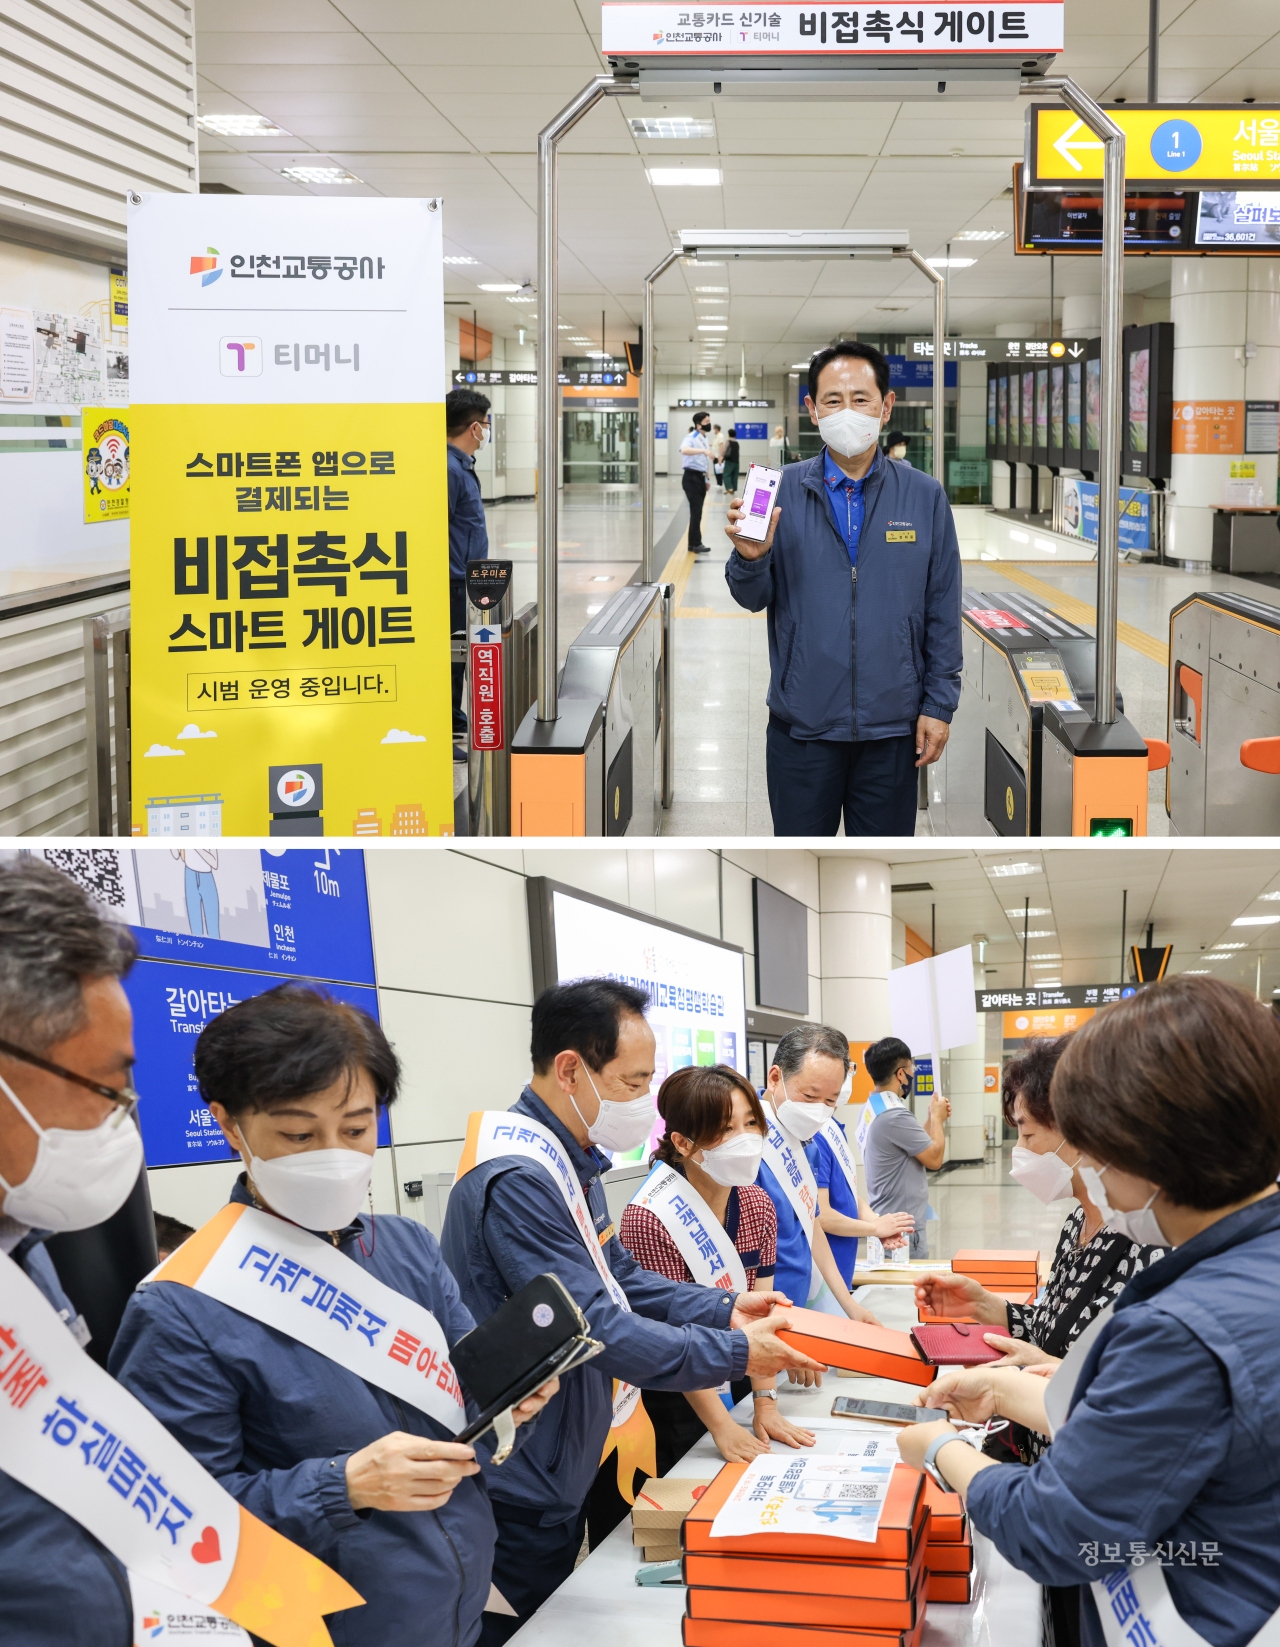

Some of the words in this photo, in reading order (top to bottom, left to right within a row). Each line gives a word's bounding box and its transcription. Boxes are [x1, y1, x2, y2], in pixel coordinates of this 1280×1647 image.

[678, 12, 734, 28] 교통카드
[740, 12, 782, 27] 신기술
[800, 11, 924, 43] 비접촉식
[934, 10, 1028, 42] 게이트
[666, 32, 722, 42] 인천교통공사
[754, 32, 780, 42] 티머니
[1172, 131, 1179, 149] 1
[1232, 150, 1264, 161] Seoul
[230, 254, 386, 280] 인천교통공사
[274, 343, 360, 372] 티머니
[186, 452, 302, 478] 스마트폰
[312, 451, 395, 475] 앱으로
[236, 485, 349, 512] 결제되는
[173, 531, 408, 600] 비접촉식
[470, 568, 508, 579] 도우미폰
[168, 610, 286, 652] 스마트
[302, 606, 415, 650] 게이트
[196, 681, 239, 702] 시범
[248, 678, 290, 700] 운영
[299, 674, 389, 698] 중입니다.
[478, 648, 494, 702] 역직원
[478, 708, 495, 744] 호출
[270, 890, 291, 900] Jemulpo
[314, 870, 340, 898] 10m
[274, 924, 295, 944] 인천
[276, 943, 296, 952] Incheon
[982, 994, 1023, 1008] 갈아타는
[1026, 992, 1036, 1006] 곳
[185, 1130, 203, 1138] Seoul
[204, 1128, 224, 1137] Station
[493, 1126, 576, 1202] 고객님께서
[668, 1194, 725, 1276] 고객님께서
[238, 1244, 388, 1347] 고객님께서
[42, 1396, 193, 1545] 하실때까지
[748, 1474, 777, 1501] 카카오톡
[760, 1496, 789, 1526] 친구추가
[776, 1480, 797, 1494] 선물
